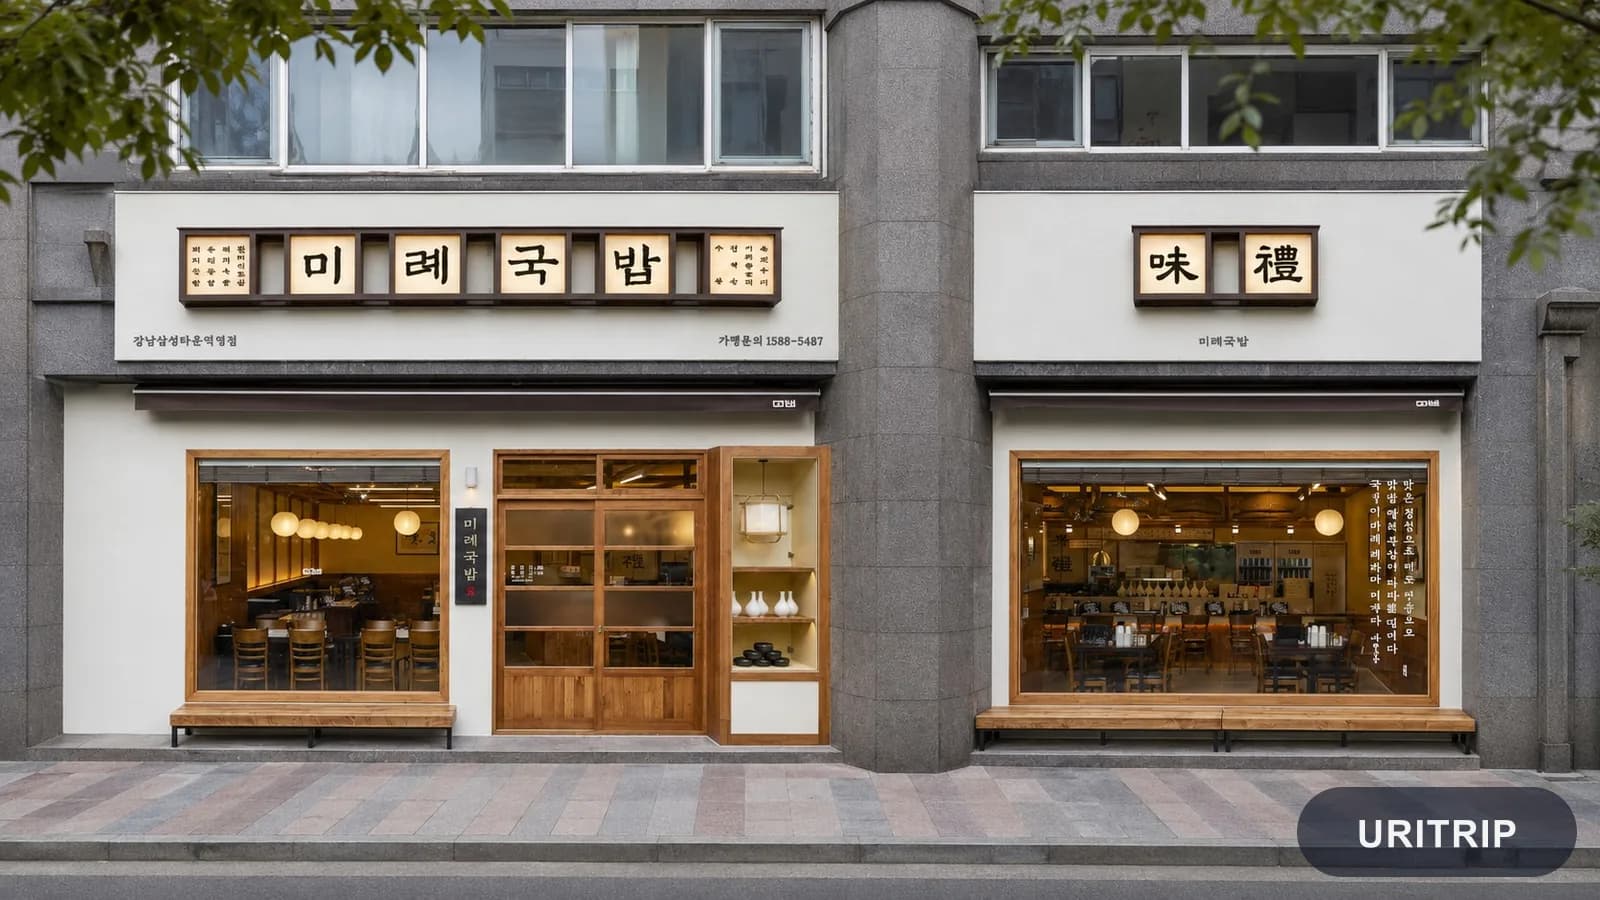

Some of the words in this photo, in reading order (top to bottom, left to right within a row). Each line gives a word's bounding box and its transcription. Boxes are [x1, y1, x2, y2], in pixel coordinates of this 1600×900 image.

[303, 244, 661, 286] 미례국밥
[1149, 245, 1303, 285] 味禮
[718, 334, 763, 348] 가맹문의
[766, 336, 824, 347] 1588-5487
